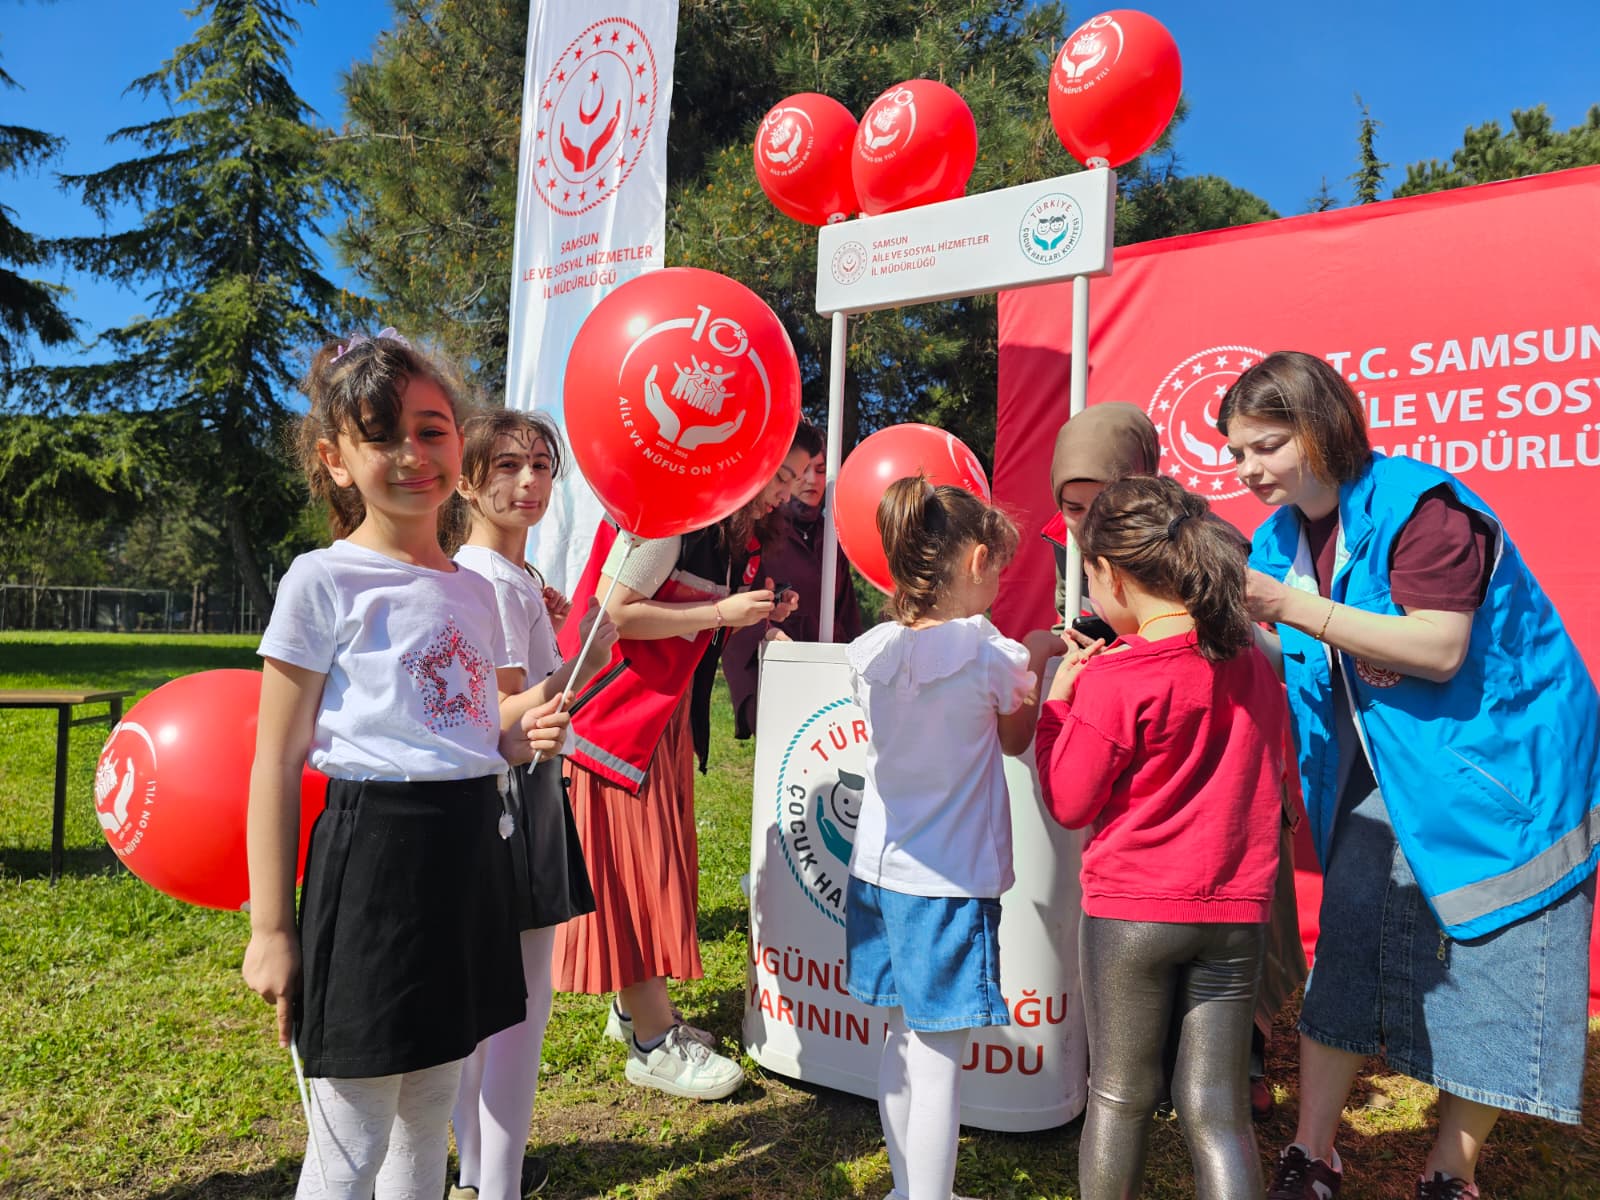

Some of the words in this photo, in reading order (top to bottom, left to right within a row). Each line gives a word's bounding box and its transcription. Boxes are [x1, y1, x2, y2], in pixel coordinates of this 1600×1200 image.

[1031, 200, 1072, 218] TÜRKİYE
[560, 232, 599, 254] SAMSUN
[871, 249, 890, 263] AİLE
[891, 249, 902, 259] VE
[903, 245, 936, 257] SOSYAL
[938, 234, 989, 252] HİZMETLER
[872, 235, 909, 249] SAMSUN
[523, 268, 536, 281] LE
[538, 267, 553, 280] VE
[554, 256, 583, 277] SOSYAL
[586, 245, 653, 266] HİZMETLER
[871, 265, 879, 276] İL
[880, 256, 936, 275] MÜDÜRLÜĞÜ
[543, 285, 552, 299] İL
[553, 269, 616, 297] MÜDÜRLÜĞÜ
[1325, 347, 1399, 382] T.C.
[1426, 388, 1485, 424] VE
[1496, 377, 1600, 419] SOS
[618, 396, 634, 428] AİLE
[629, 429, 645, 448] VE
[642, 447, 686, 475] NÜFUS
[690, 465, 712, 476] ON
[717, 451, 743, 471] YILI
[810, 719, 869, 762] TÜR
[144, 780, 157, 805] YILI
[138, 810, 151, 829] ON
[786, 783, 818, 872] ÇOCUK
[813, 872, 847, 914] HA
[749, 979, 869, 1046] YARININ
